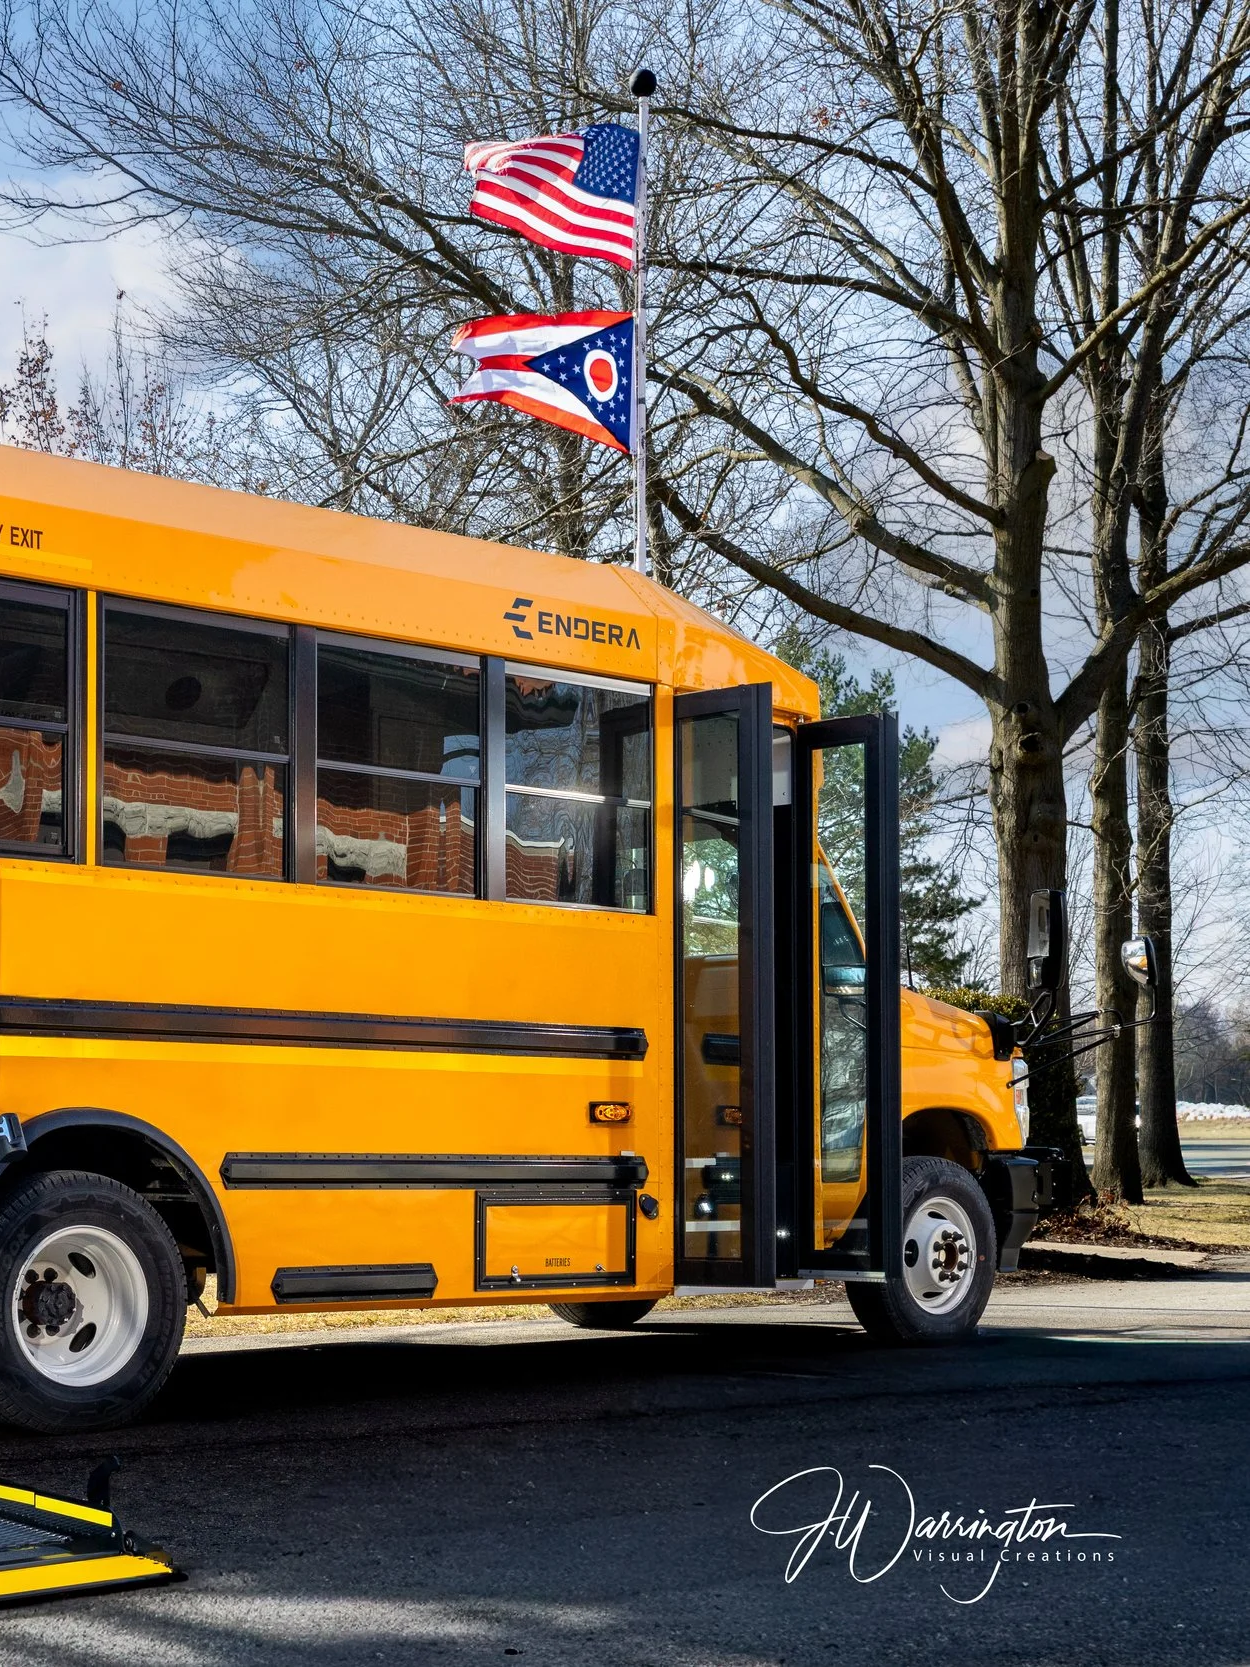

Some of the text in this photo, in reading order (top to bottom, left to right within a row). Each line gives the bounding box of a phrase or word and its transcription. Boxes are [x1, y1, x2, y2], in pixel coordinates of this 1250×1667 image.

[10, 526, 43, 549] EXIT
[538, 611, 641, 650] ENDERA
[545, 1257, 570, 1267] BATTERIES
